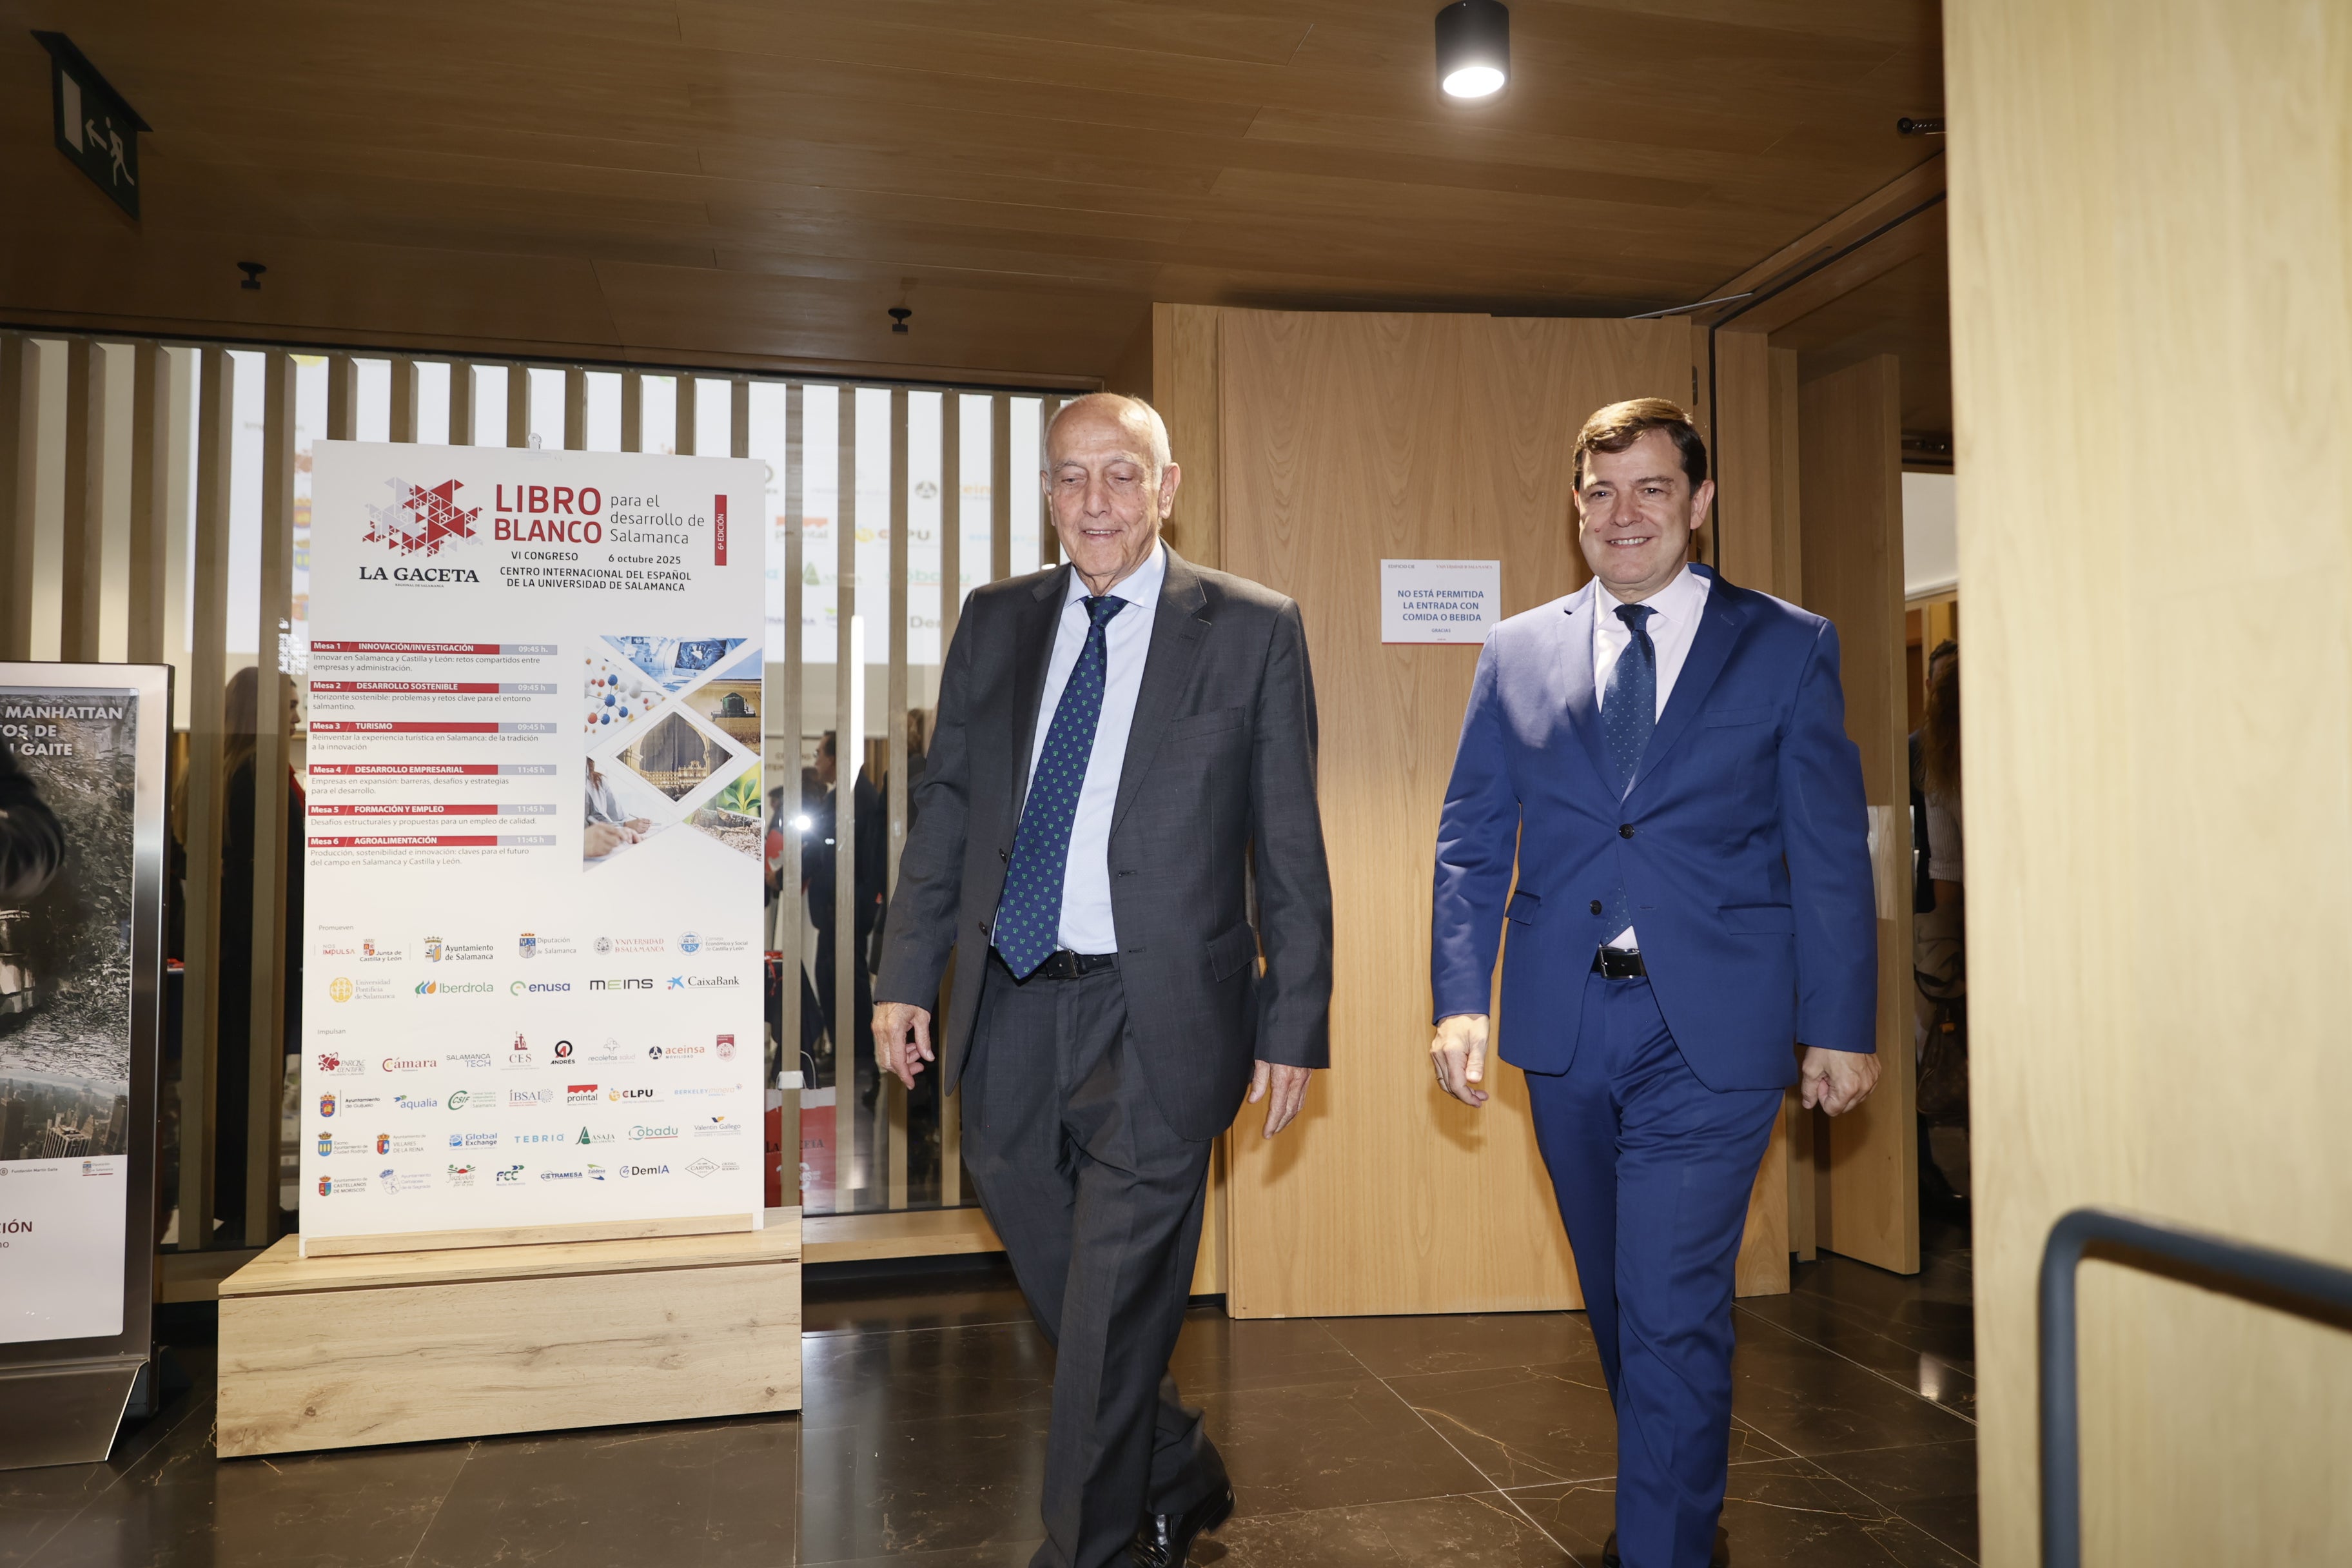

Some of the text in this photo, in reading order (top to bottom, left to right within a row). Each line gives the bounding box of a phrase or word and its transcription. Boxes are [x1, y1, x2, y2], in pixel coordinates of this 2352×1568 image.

[496, 484, 601, 516] LIBRO
[611, 495, 660, 508] para el
[611, 511, 704, 527] desarrollo de
[495, 518, 602, 544] BLANCO
[716, 513, 725, 542] EDICIÓN
[611, 529, 688, 544] Salamanca
[524, 551, 578, 561] CONGRESO
[618, 555, 653, 564] octubre
[656, 556, 681, 564] 2025
[359, 567, 480, 583] LA GACETA
[500, 567, 691, 580] CENTRO INTERNACIONAL DEL ESPAÑOL
[507, 578, 519, 587] DE
[538, 579, 606, 589] UNIVERSIDAD
[625, 582, 685, 591] SALAMANCA
[1413, 589, 1434, 598] ESTÁ
[358, 642, 474, 652] INNOVACIÓN/INVESTIGACIÓN
[410, 682, 458, 691] SOSTENIBLE
[6, 707, 122, 719] MANHATTAN
[0, 724, 56, 737] OS DE
[21, 743, 72, 755] GAITE
[354, 804, 404, 813] FORMACIÓN
[354, 836, 438, 845] AGROALIMENTACIÓN
[445, 945, 493, 953] Ayuntamiento
[688, 976, 739, 986] CaixaBank
[440, 982, 493, 994] Iberdrola
[529, 983, 570, 992] enusa
[665, 1045, 705, 1054] aceinsa
[509, 1054, 531, 1063] CES
[382, 1057, 436, 1072] Cámara
[567, 1094, 598, 1103] prointal
[623, 1090, 653, 1098] CLPU
[400, 1099, 437, 1110] aqualia
[0, 1219, 33, 1234] IÓN
